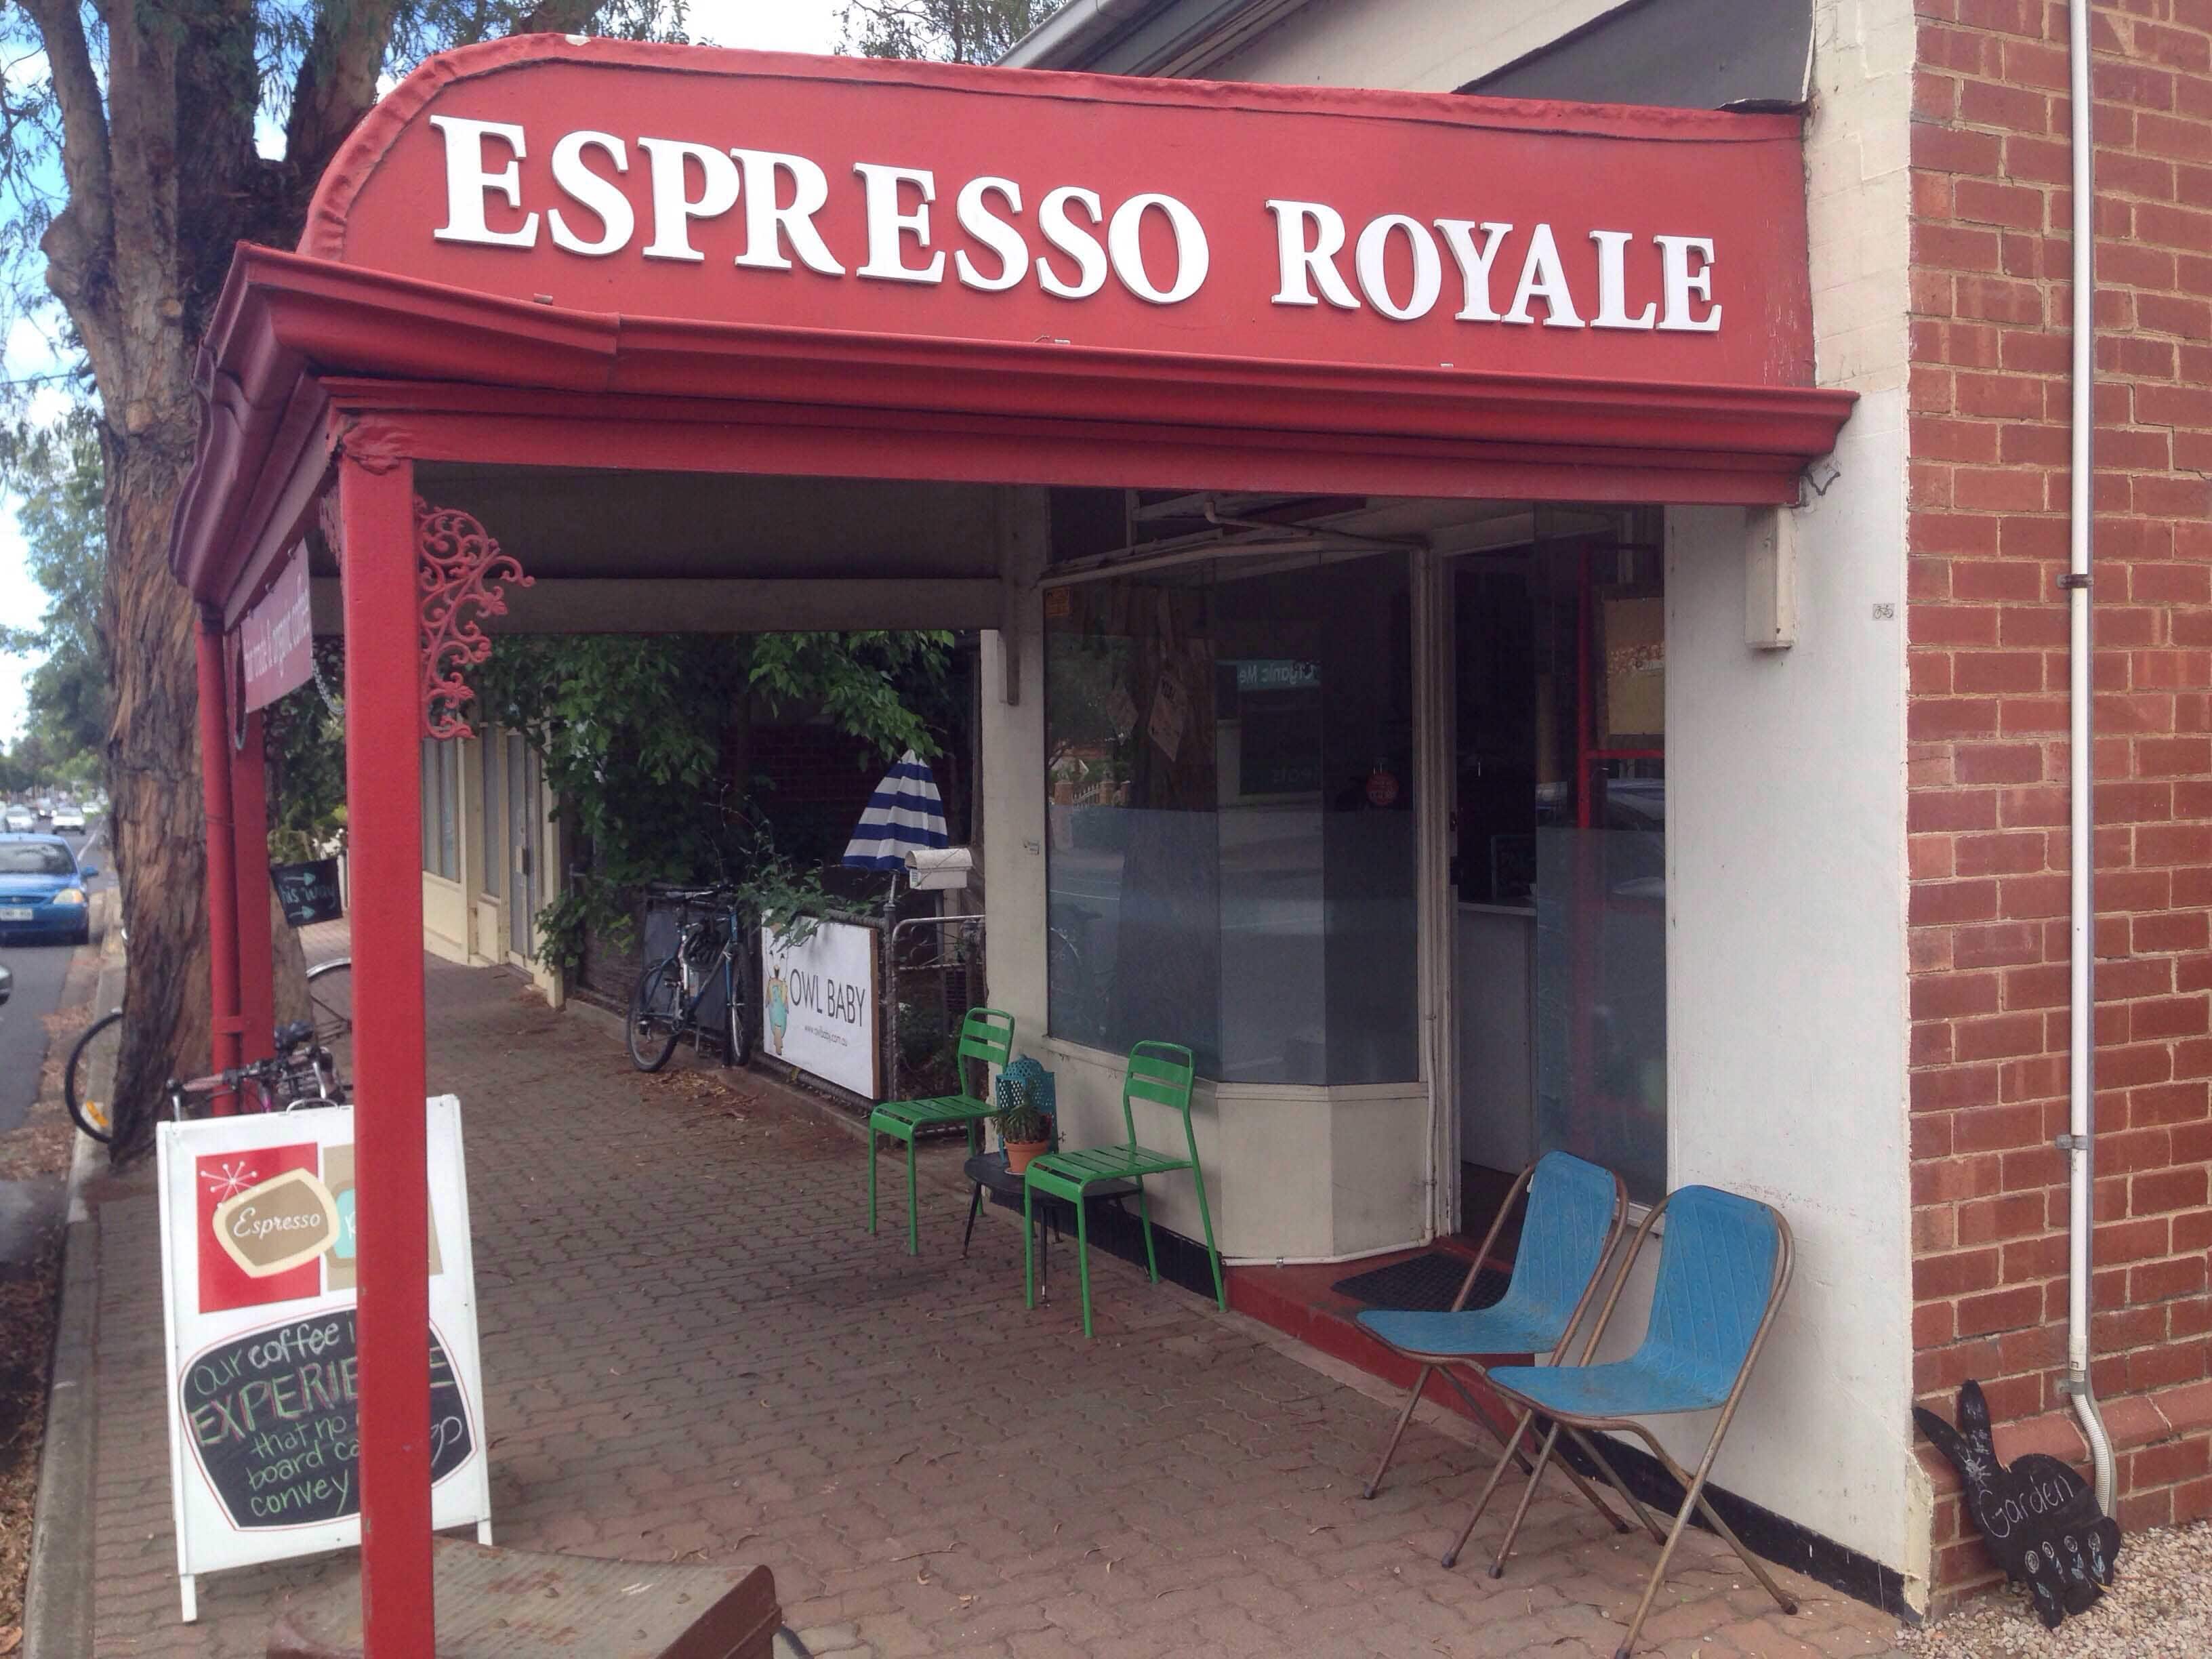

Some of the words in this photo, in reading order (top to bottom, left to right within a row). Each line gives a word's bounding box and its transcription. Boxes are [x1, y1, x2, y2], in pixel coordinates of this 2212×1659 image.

[430, 115, 1210, 306] ESPRESSO
[1265, 199, 1722, 333] ROYALE
[790, 968, 822, 1015] OWL
[827, 979, 865, 1027] BABY
[233, 1207, 321, 1241] Espresso
[248, 1322, 340, 1369] coffee
[249, 1422, 309, 1459] that
[314, 1415, 347, 1441] no
[245, 1439, 325, 1492] board
[251, 1469, 349, 1517] convey
[1979, 1473, 2074, 1538] Garden
